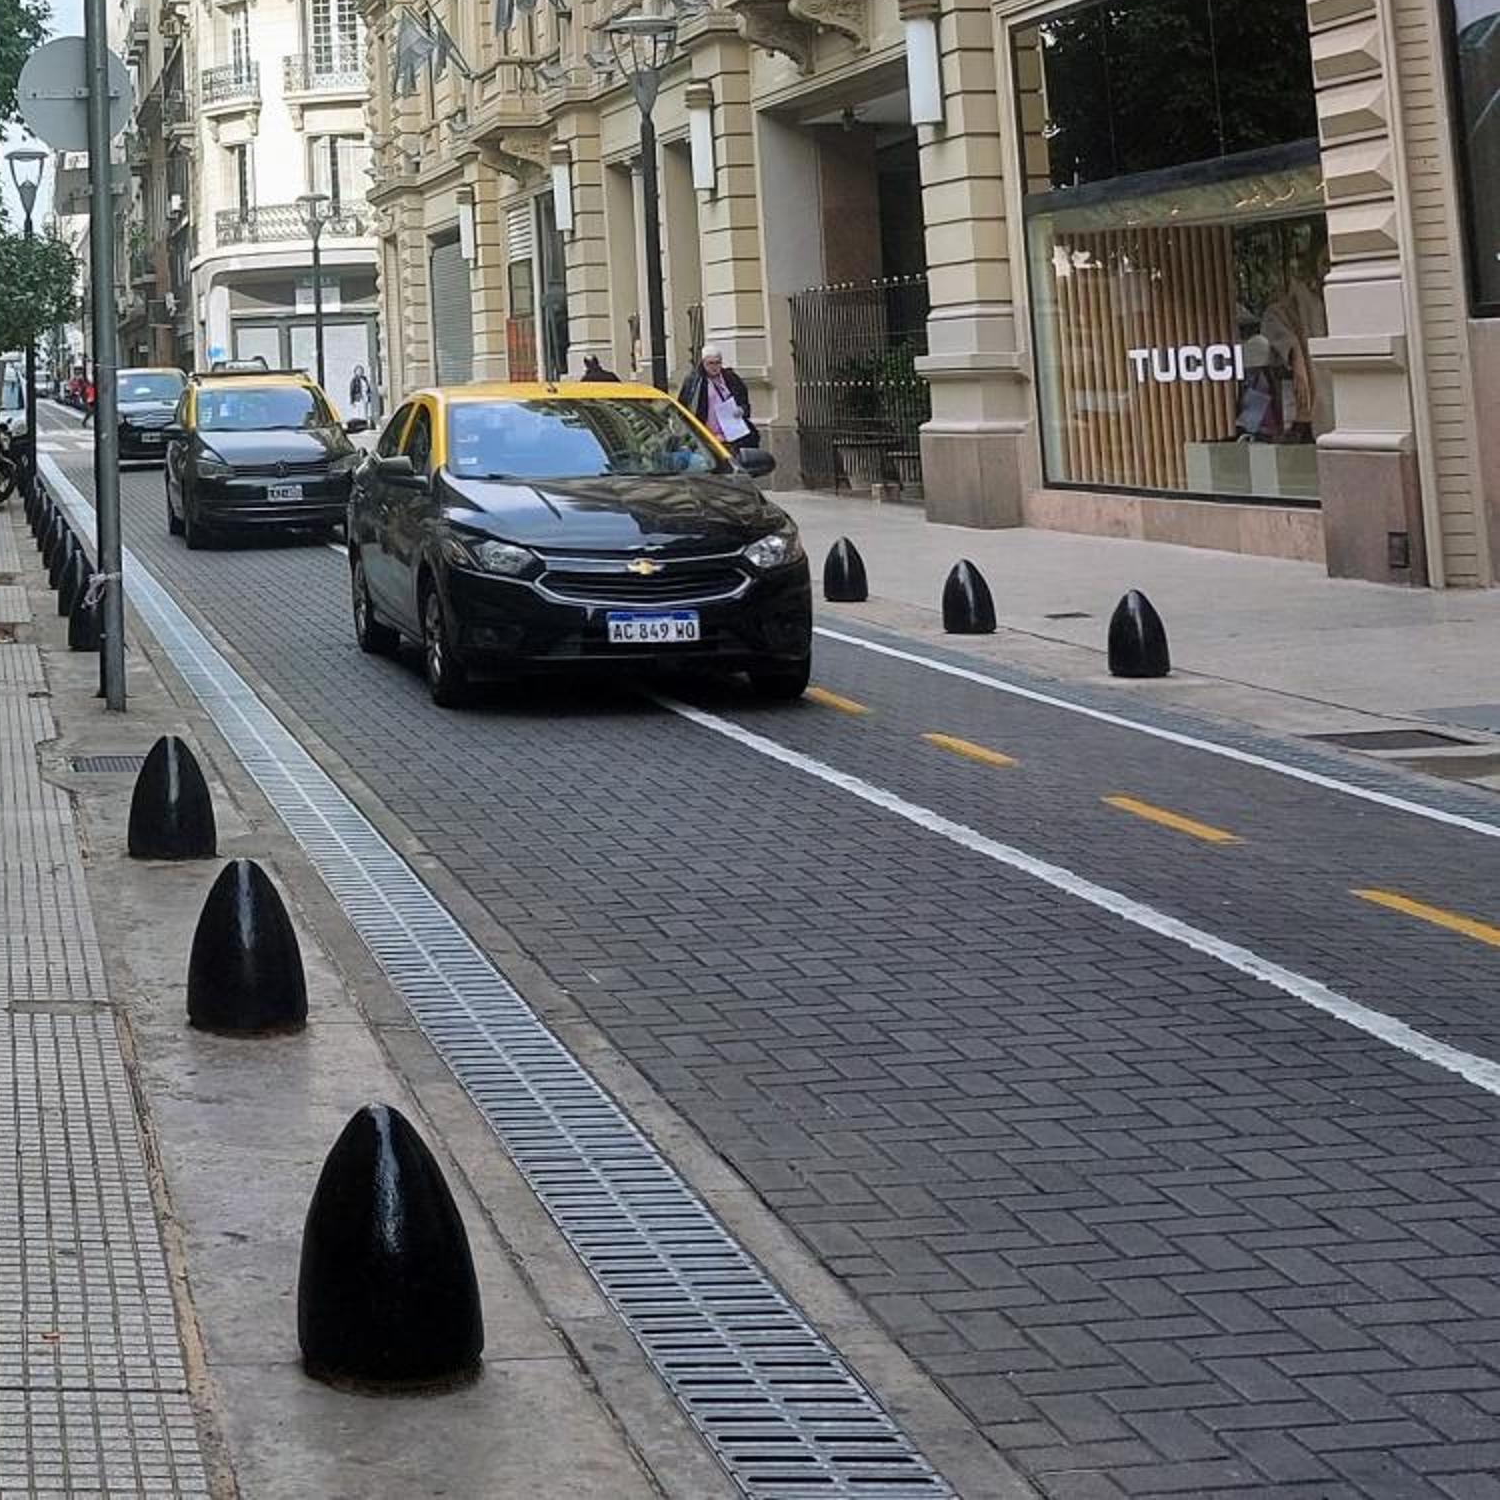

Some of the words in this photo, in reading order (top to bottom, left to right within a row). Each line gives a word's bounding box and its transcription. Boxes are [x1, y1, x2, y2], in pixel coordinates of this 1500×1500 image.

[1128, 344, 1244, 383] TUCCI
[613, 623, 633, 640] AC
[640, 623, 669, 639] 849
